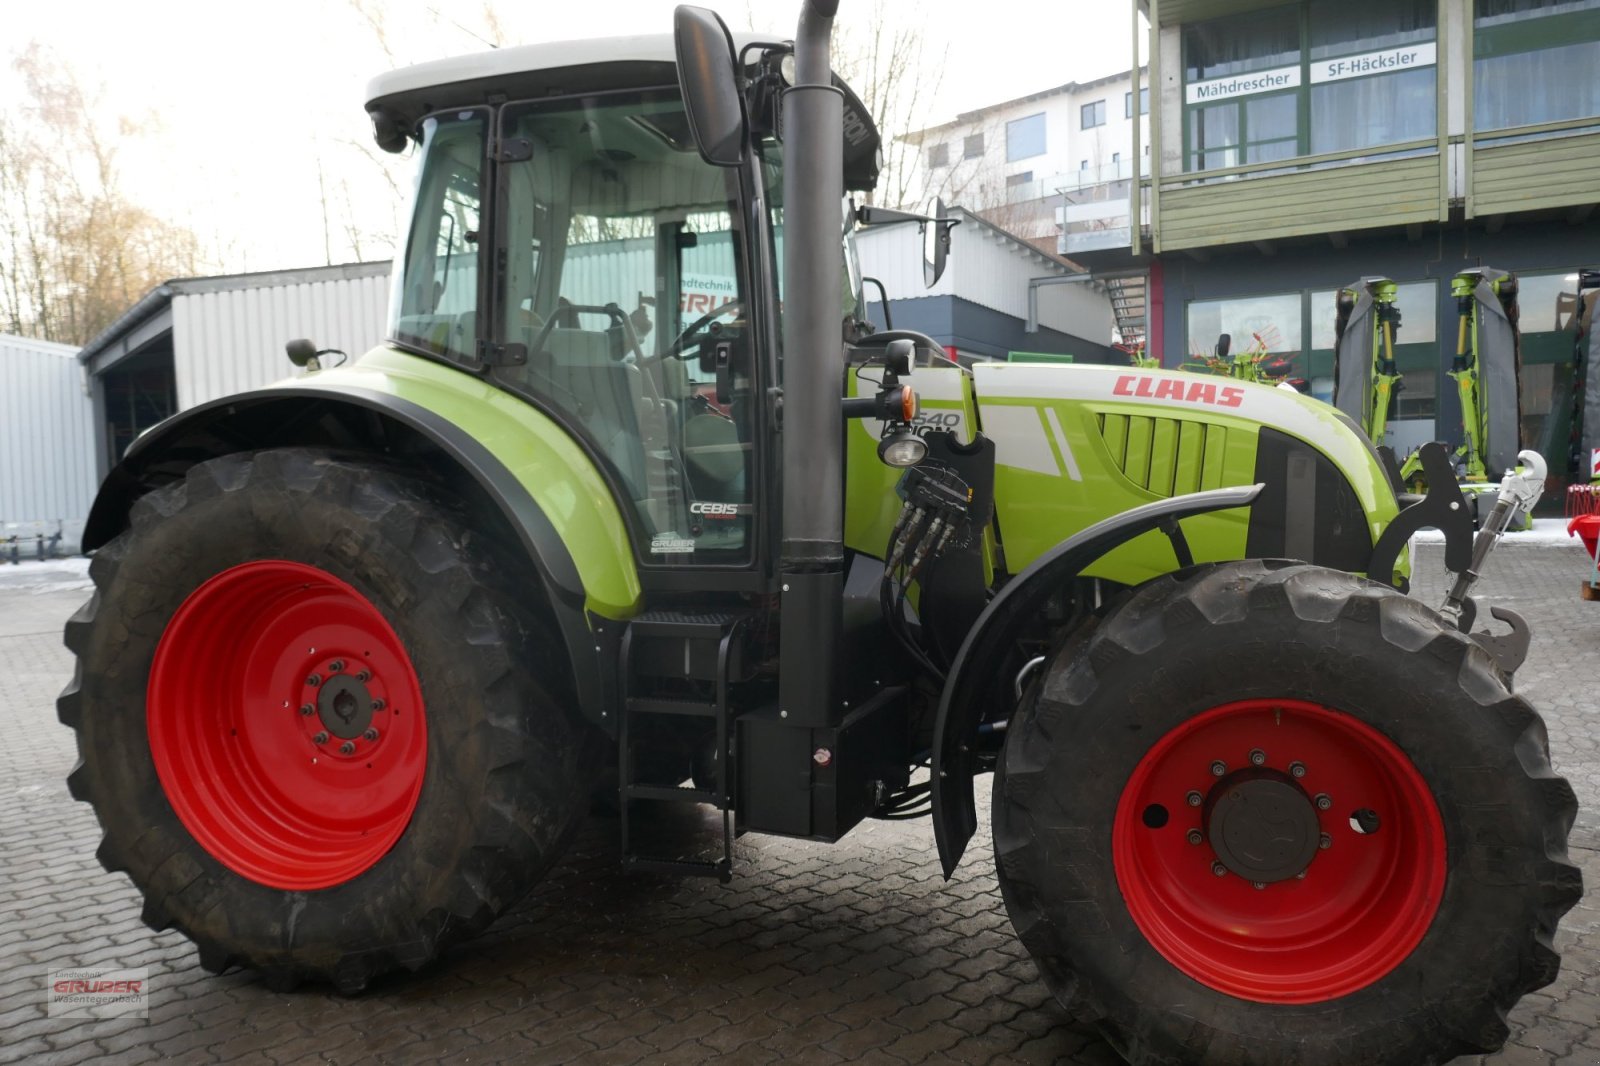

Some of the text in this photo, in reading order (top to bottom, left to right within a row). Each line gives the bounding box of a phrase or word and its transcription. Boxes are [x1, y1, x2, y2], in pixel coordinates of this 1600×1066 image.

[1328, 52, 1418, 77] SF-Häcksler
[1197, 73, 1290, 98] Mähdrescher
[843, 105, 870, 146] RION
[681, 279, 733, 291] ndtechnik
[1112, 375, 1245, 408] CLAAS
[690, 503, 738, 514] CEBIS
